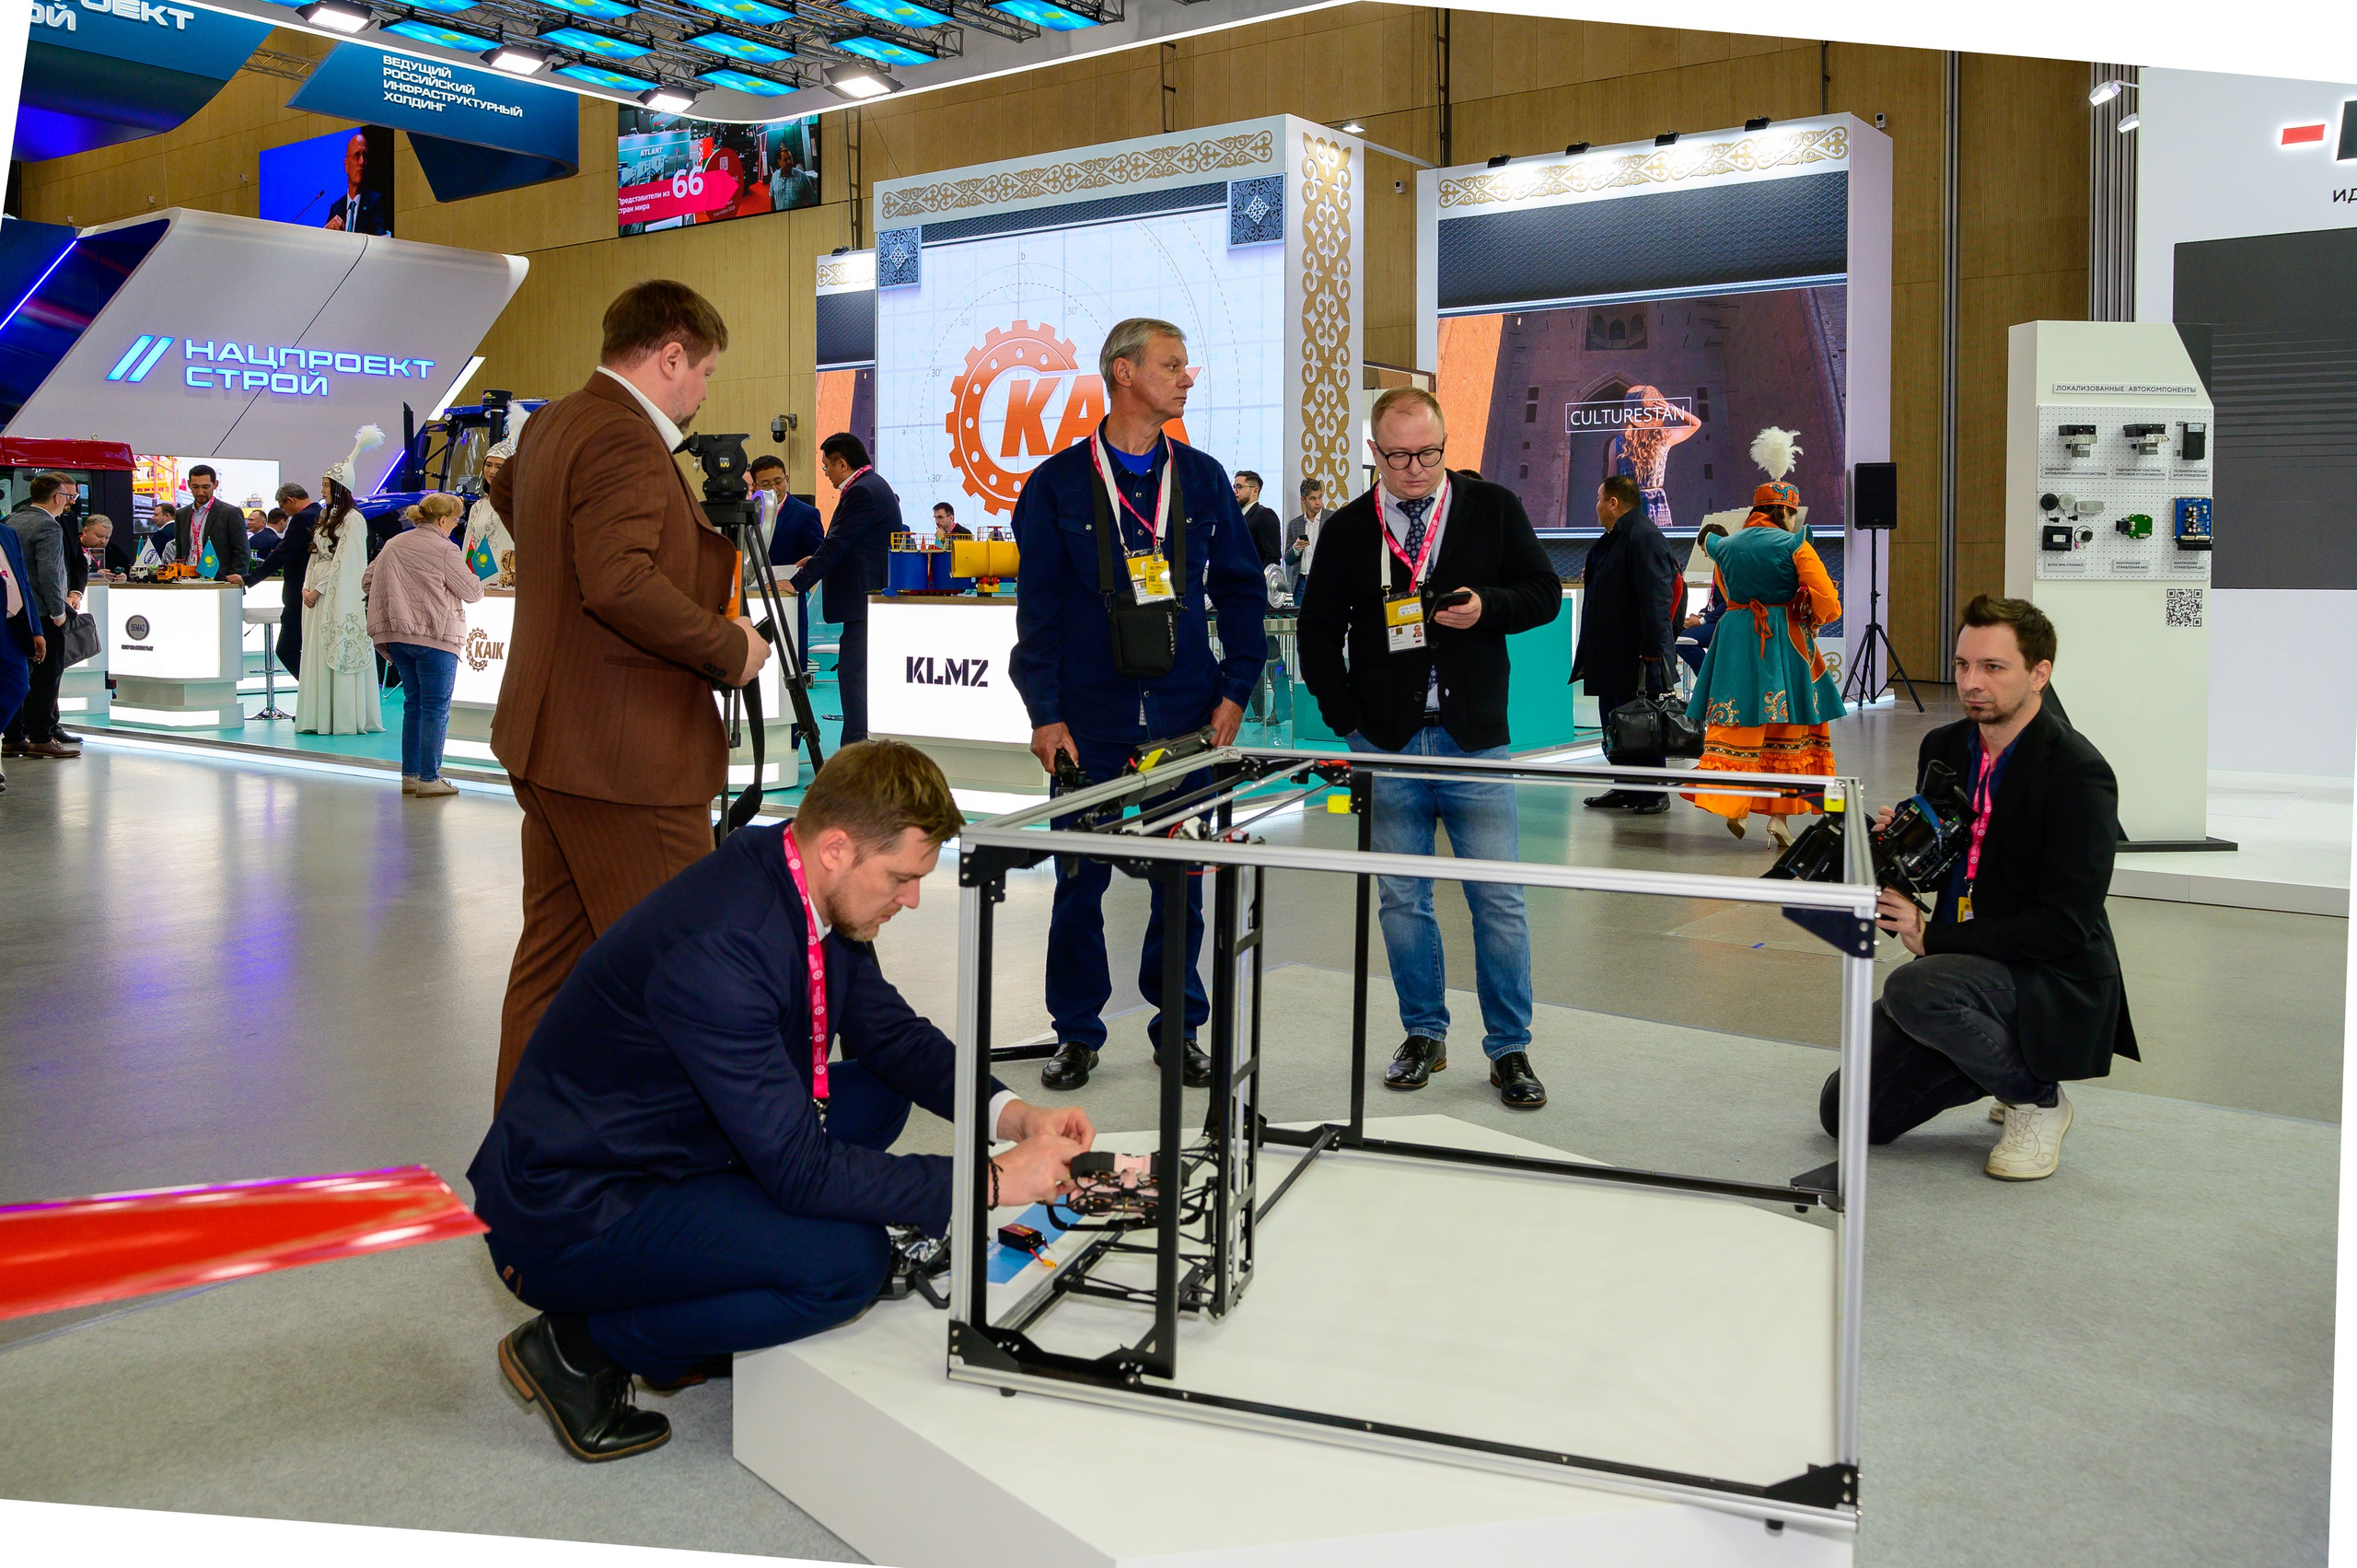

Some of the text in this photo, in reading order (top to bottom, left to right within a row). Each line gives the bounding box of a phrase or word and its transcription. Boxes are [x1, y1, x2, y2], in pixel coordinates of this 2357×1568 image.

[80, 0, 194, 29] ОЕКТ
[383, 55, 451, 78] ВЕДУЩИЙ
[383, 67, 475, 96] РОССИЙСКИЙ
[383, 79, 523, 117] ИНФРАСТРУКТУРНЫЙ
[383, 91, 447, 112] ХОЛДИНГ
[640, 147, 663, 157] ATLANT
[672, 166, 703, 198] 66
[185, 338, 435, 378] НАЦПРОЕКТ
[186, 366, 329, 396] СТРОЙ
[1570, 406, 1685, 425] CULTURESTAN
[131, 623, 145, 632] SEMAZ
[474, 641, 505, 660] KAIK
[906, 656, 989, 688] KLMZ
